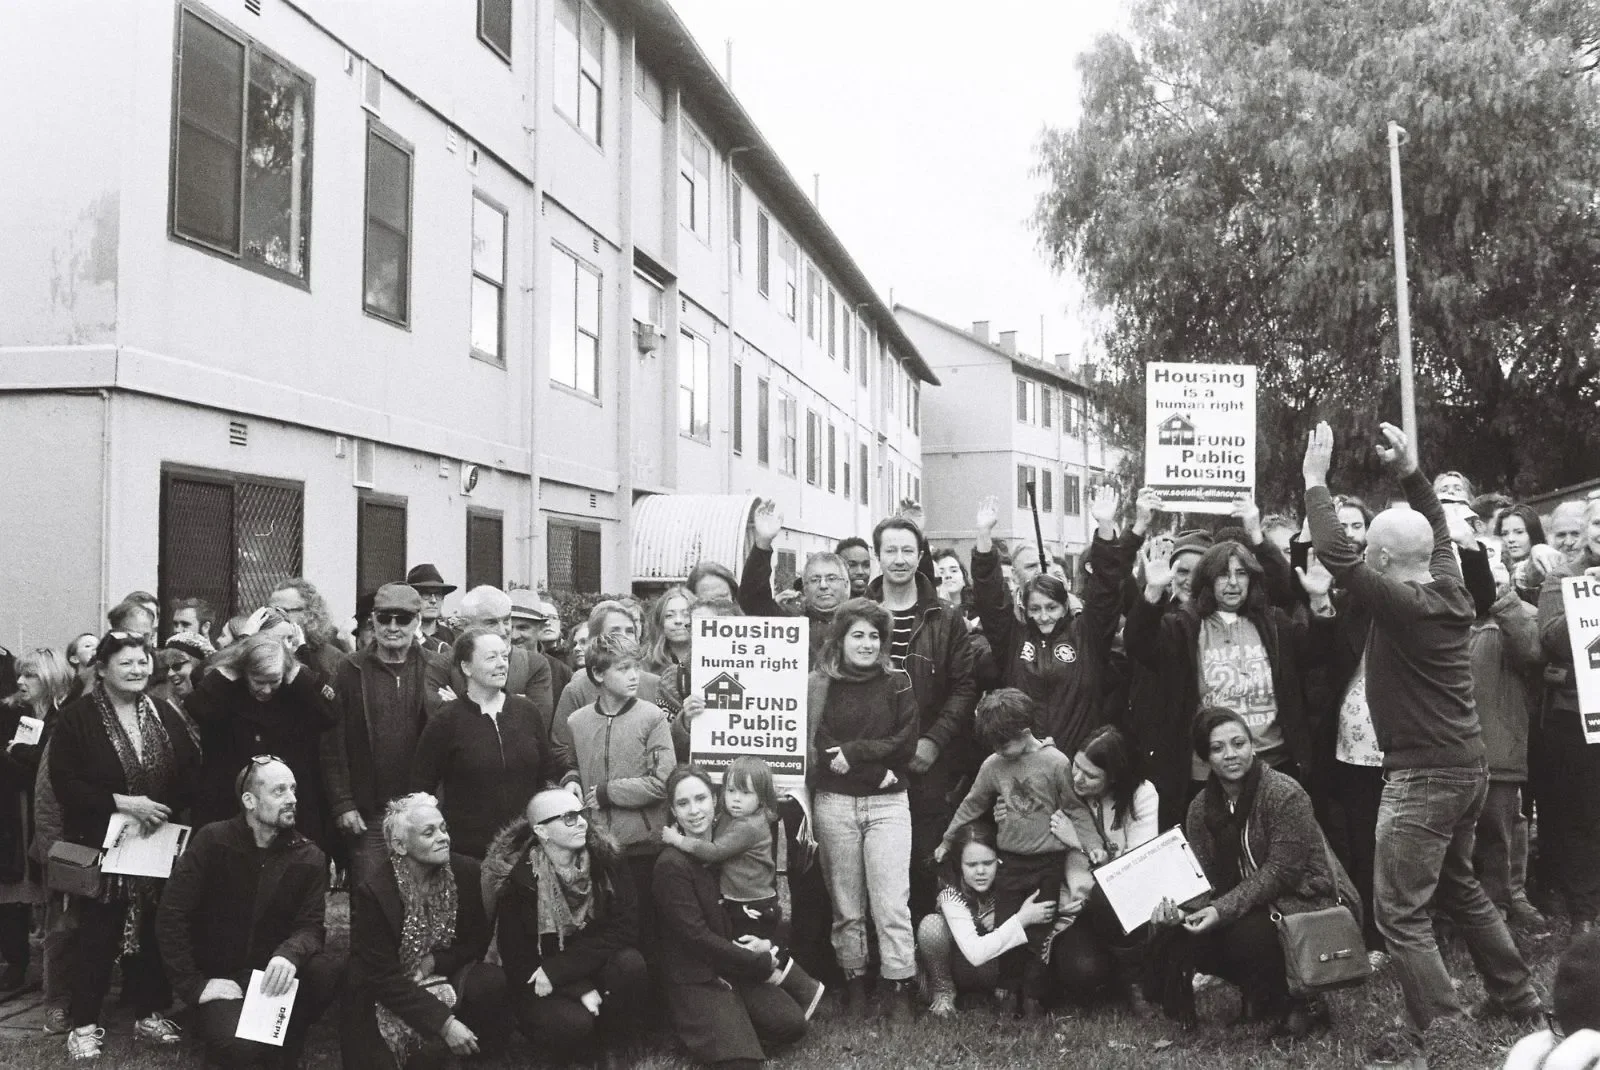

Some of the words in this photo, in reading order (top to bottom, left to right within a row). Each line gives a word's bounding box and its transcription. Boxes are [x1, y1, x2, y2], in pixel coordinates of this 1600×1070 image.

[1154, 369, 1245, 388] Housing
[1183, 386, 1198, 397] is
[1205, 389, 1215, 397] a
[1155, 400, 1205, 409] human
[1210, 401, 1245, 412] right
[1197, 435, 1246, 447] FUND
[1182, 450, 1245, 464] Public
[1166, 465, 1246, 483] Housing
[701, 620, 800, 643] Housing
[731, 640, 748, 655] is
[754, 644, 766, 655] a
[701, 655, 755, 669] human
[760, 657, 799, 672] right
[745, 696, 798, 711] FUND
[728, 713, 797, 731] Public
[711, 731, 798, 753] Housing
